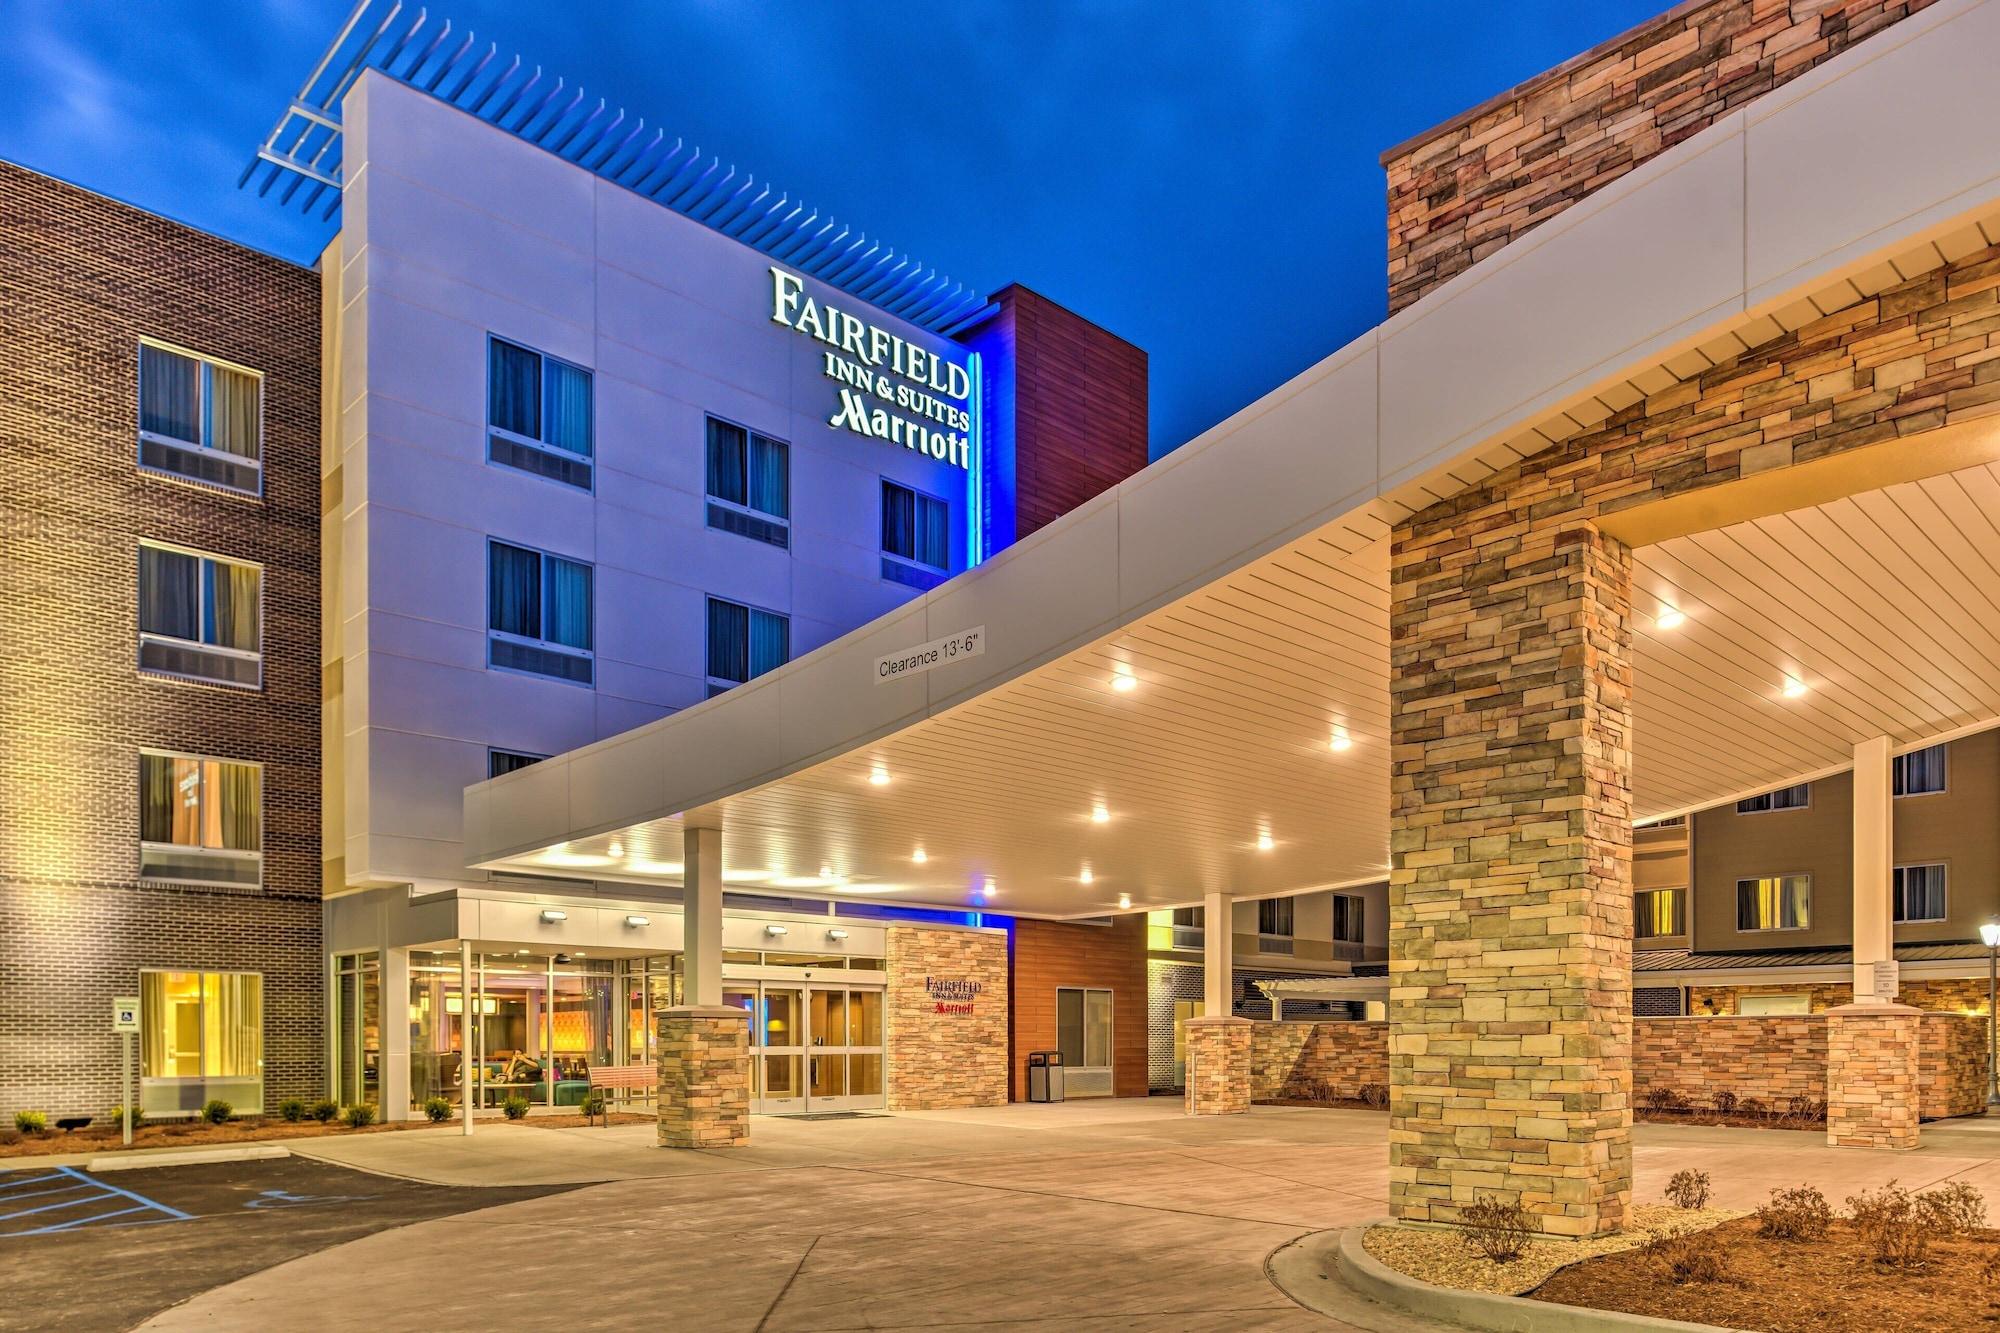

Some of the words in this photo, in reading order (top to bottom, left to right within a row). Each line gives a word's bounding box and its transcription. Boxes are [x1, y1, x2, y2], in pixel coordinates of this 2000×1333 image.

[769, 266, 970, 400] FAIRFIELD
[825, 352, 873, 393] INN
[876, 376, 894, 401] &
[897, 385, 970, 432] SUITES
[829, 389, 970, 469] Marriott
[880, 650, 938, 677] Clearance
[942, 633, 978, 658] 13'-6"
[926, 977, 981, 993] FAIRFIELD
[934, 1002, 974, 1014] Marriott
